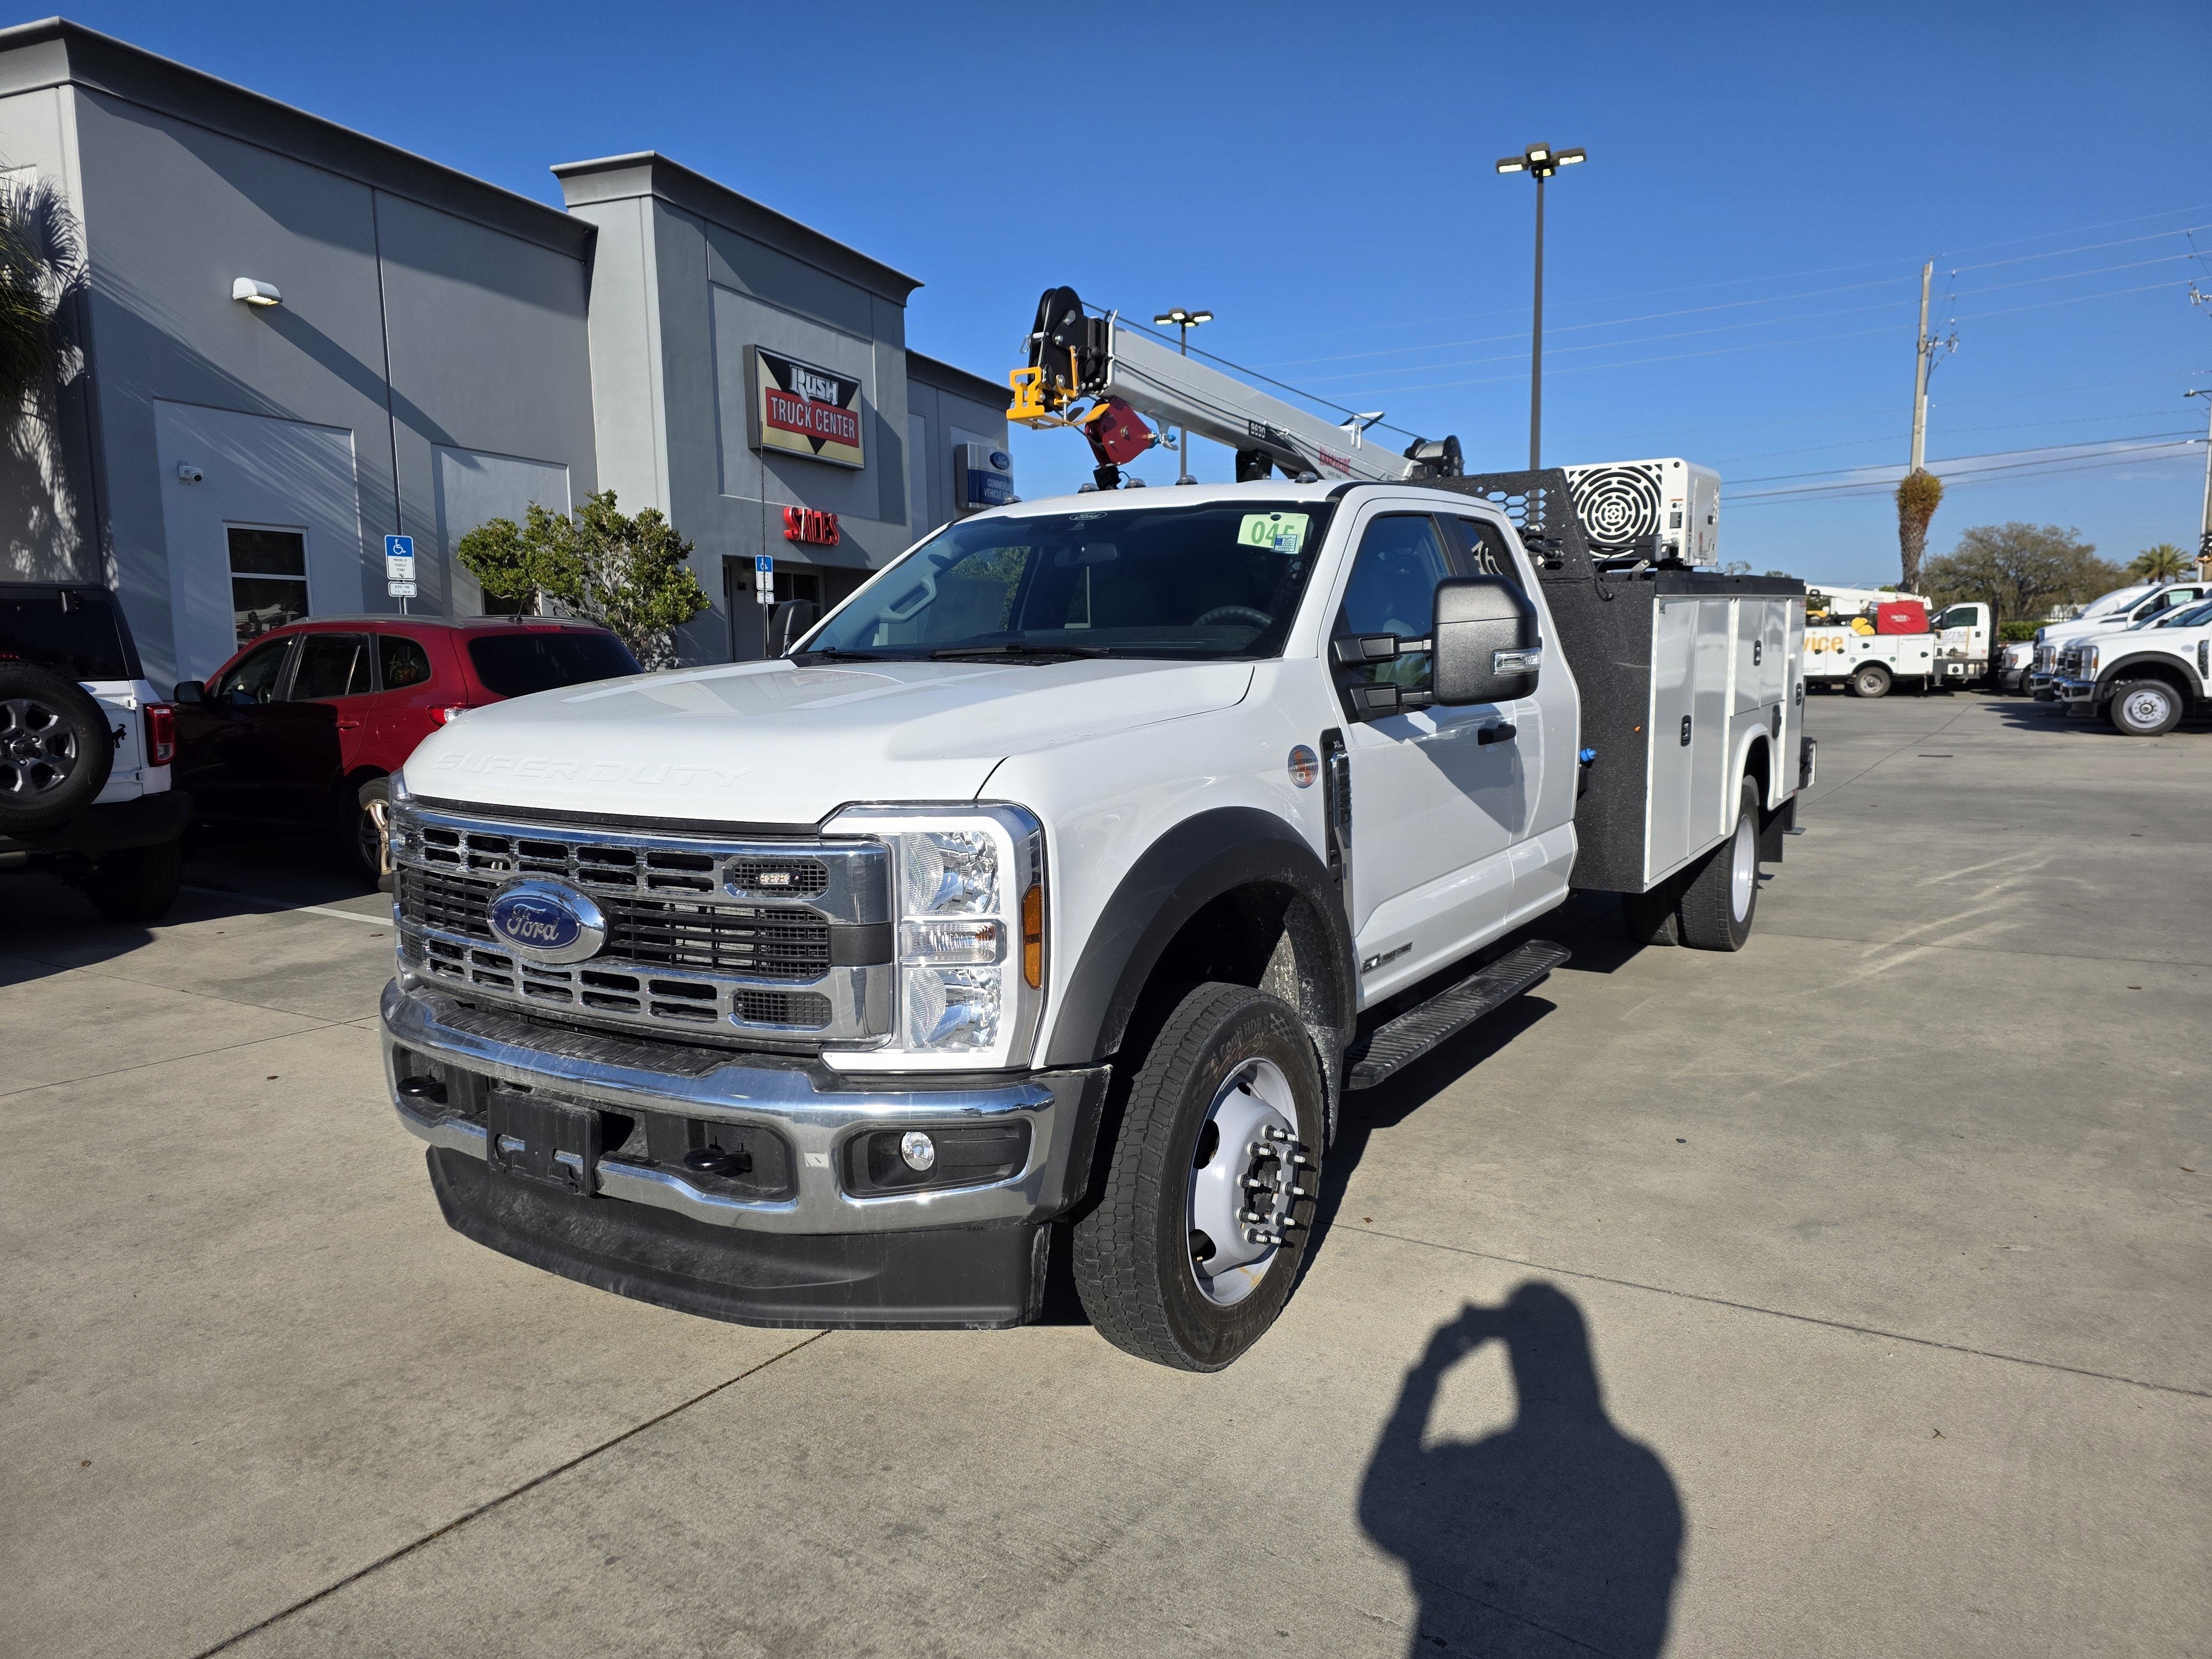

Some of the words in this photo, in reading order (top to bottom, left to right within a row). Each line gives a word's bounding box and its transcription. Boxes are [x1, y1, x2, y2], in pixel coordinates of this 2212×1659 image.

[770, 396, 812, 429] TRUCK
[815, 407, 855, 439] CENTER
[984, 487, 1001, 499] VEHICLE
[783, 507, 840, 546] SALES
[1333, 740, 1343, 748] XL
[433, 751, 583, 780] SUPER
[586, 762, 755, 787] DUTY
[507, 903, 561, 940] Ford
[1220, 1026, 1243, 1060] Conti
